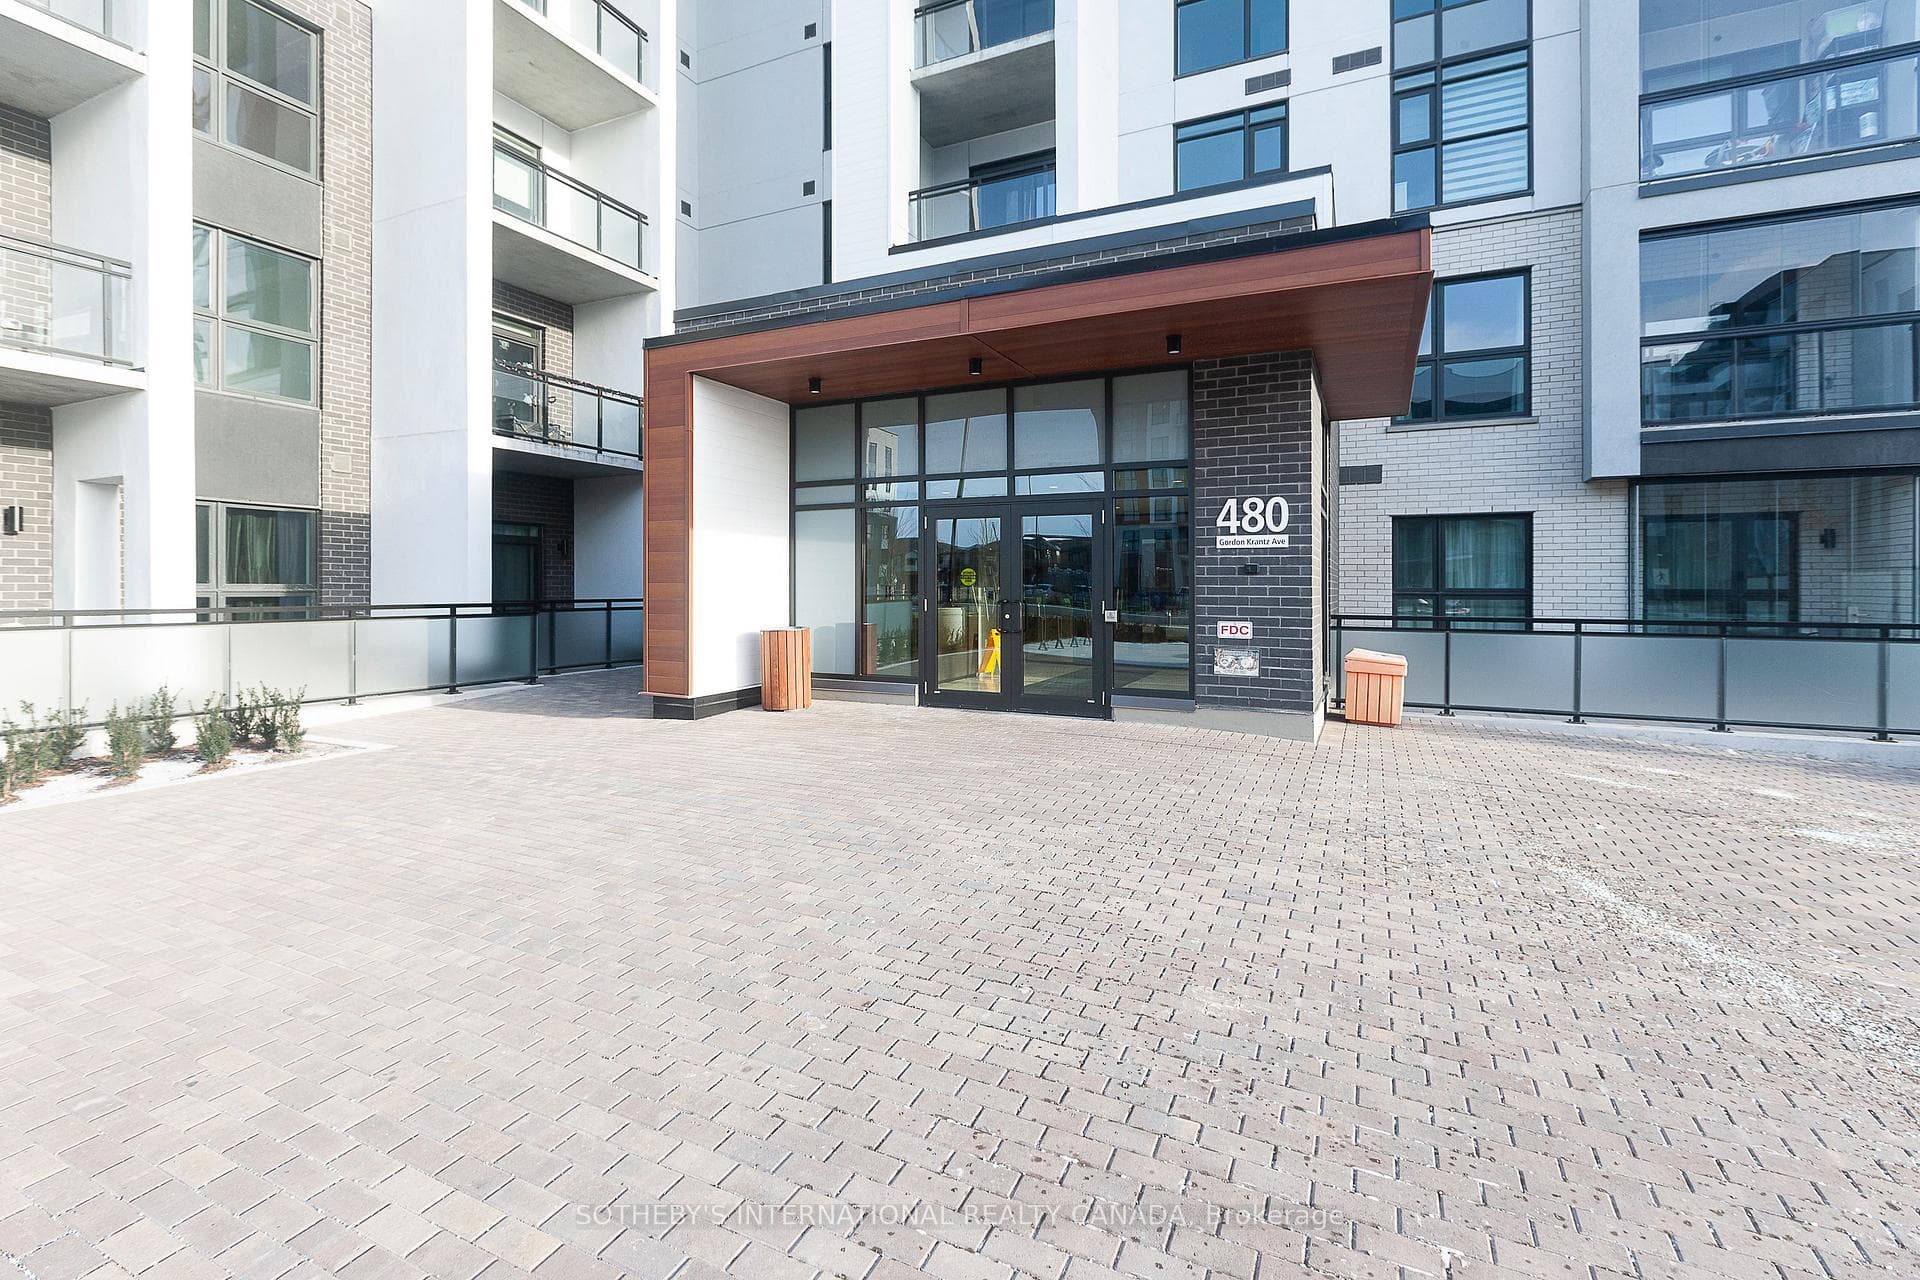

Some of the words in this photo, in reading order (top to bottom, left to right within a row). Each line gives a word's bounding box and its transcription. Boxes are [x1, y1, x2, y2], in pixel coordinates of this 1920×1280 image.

[1216, 497, 1289, 533] 480
[1219, 538, 1245, 546] Gordon
[1246, 538, 1270, 546] Krantz
[1271, 537, 1286, 545] Ave
[1220, 625, 1249, 636] FDC
